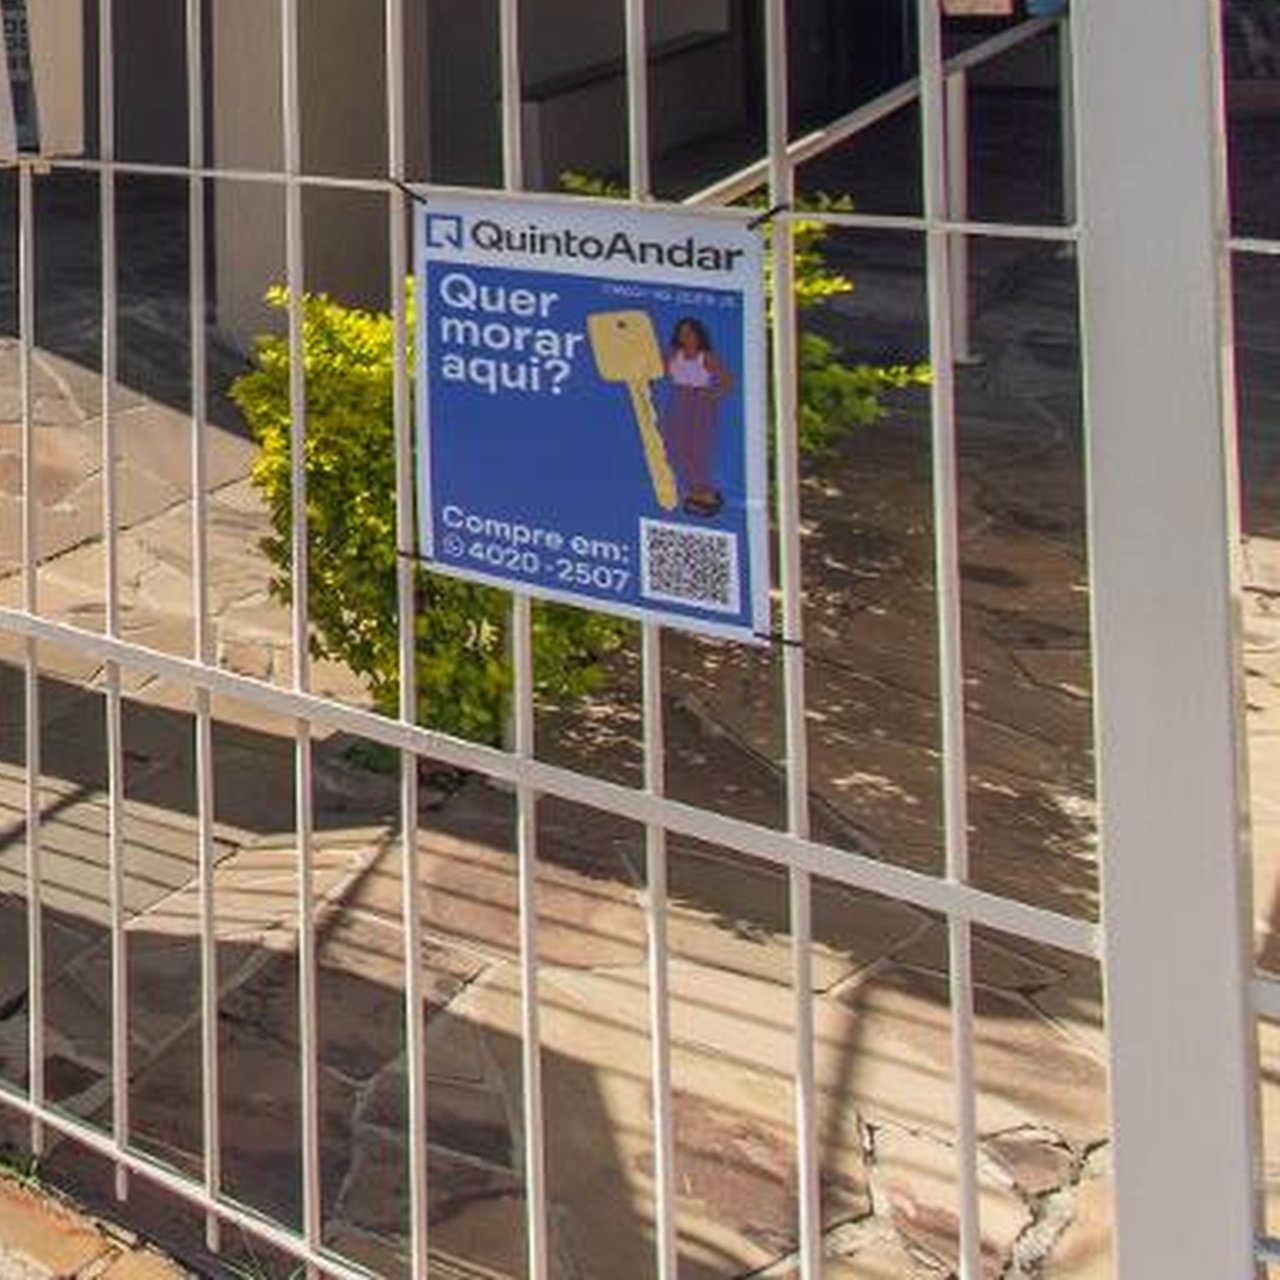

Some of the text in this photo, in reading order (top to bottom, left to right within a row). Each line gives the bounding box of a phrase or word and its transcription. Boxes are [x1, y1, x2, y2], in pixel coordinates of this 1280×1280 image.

[471, 220, 745, 271] QuintoAndar
[440, 272, 559, 317] Quer
[440, 316, 584, 359] morar
[441, 353, 571, 394] aqui?
[442, 505, 630, 564] Compre em:
